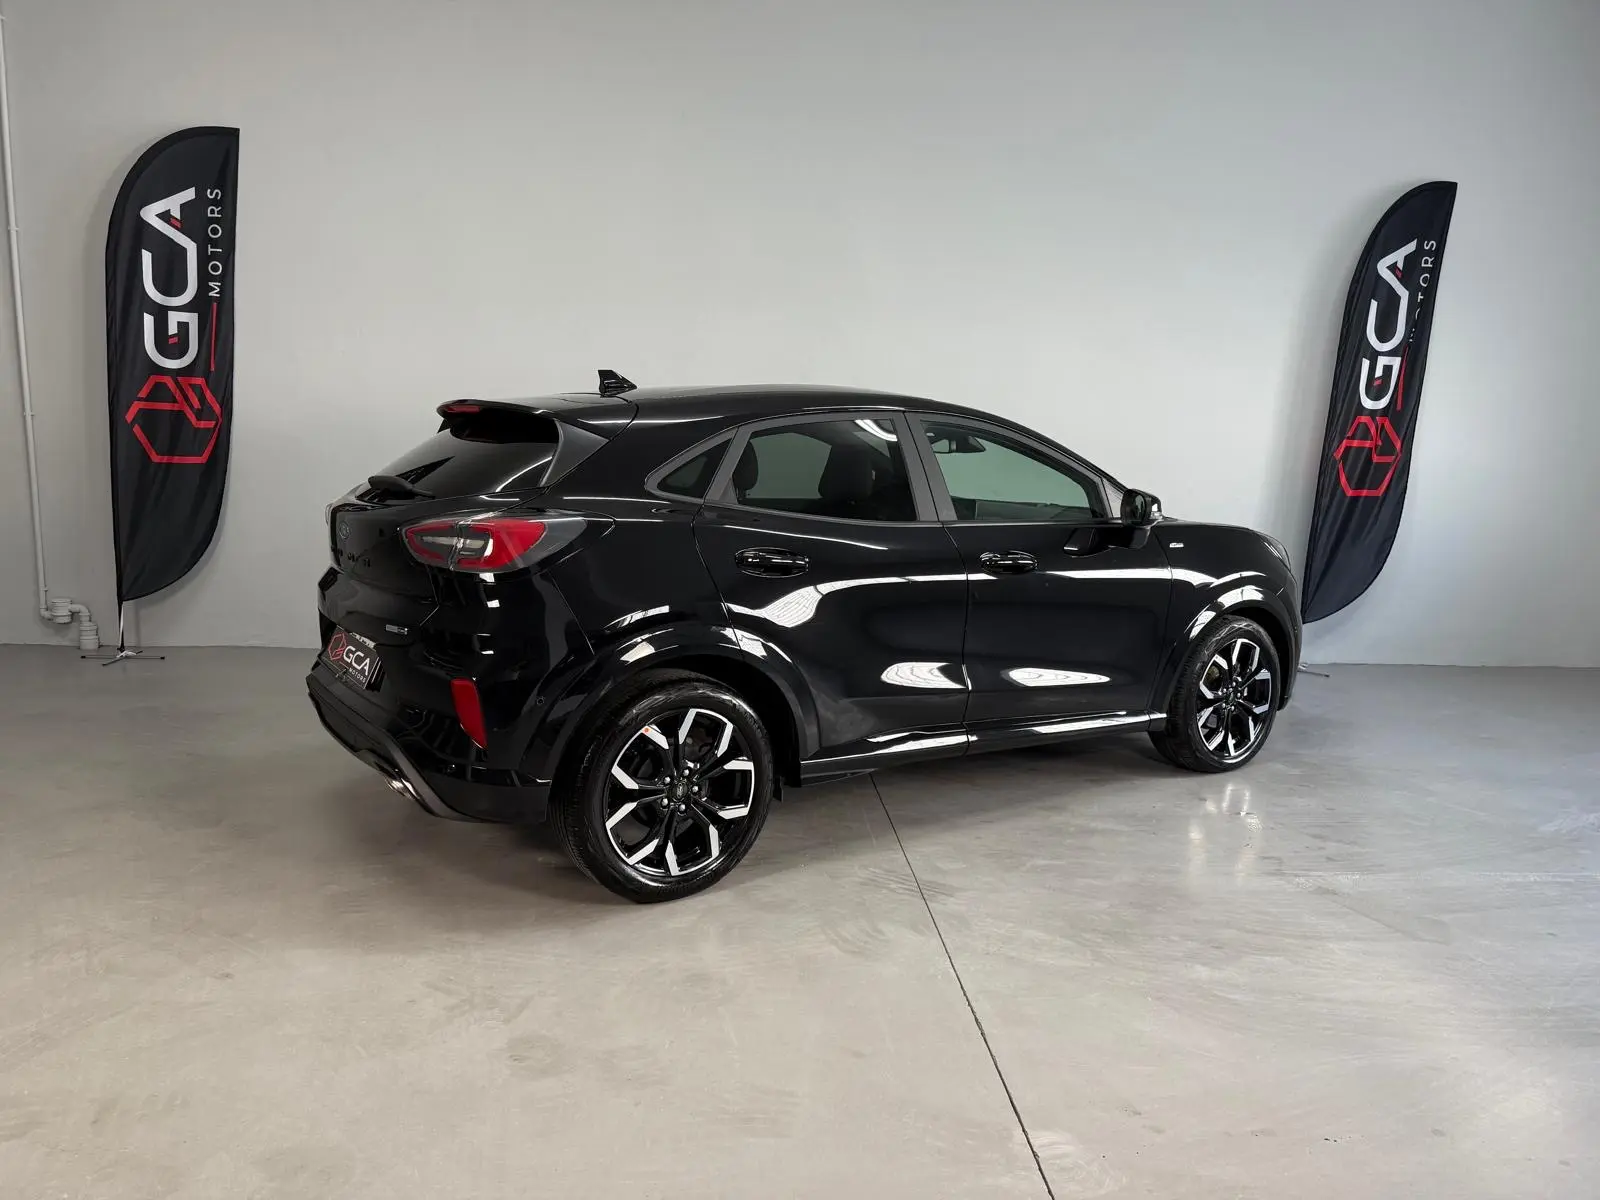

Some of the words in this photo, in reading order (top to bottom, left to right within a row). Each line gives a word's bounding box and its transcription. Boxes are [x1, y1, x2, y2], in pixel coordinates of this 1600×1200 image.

[139, 186, 199, 369] GCA
[207, 187, 223, 298] MOTORS
[1408, 240, 1437, 342] TORS
[1358, 238, 1417, 410] GCA
[343, 645, 370, 676] GCA
